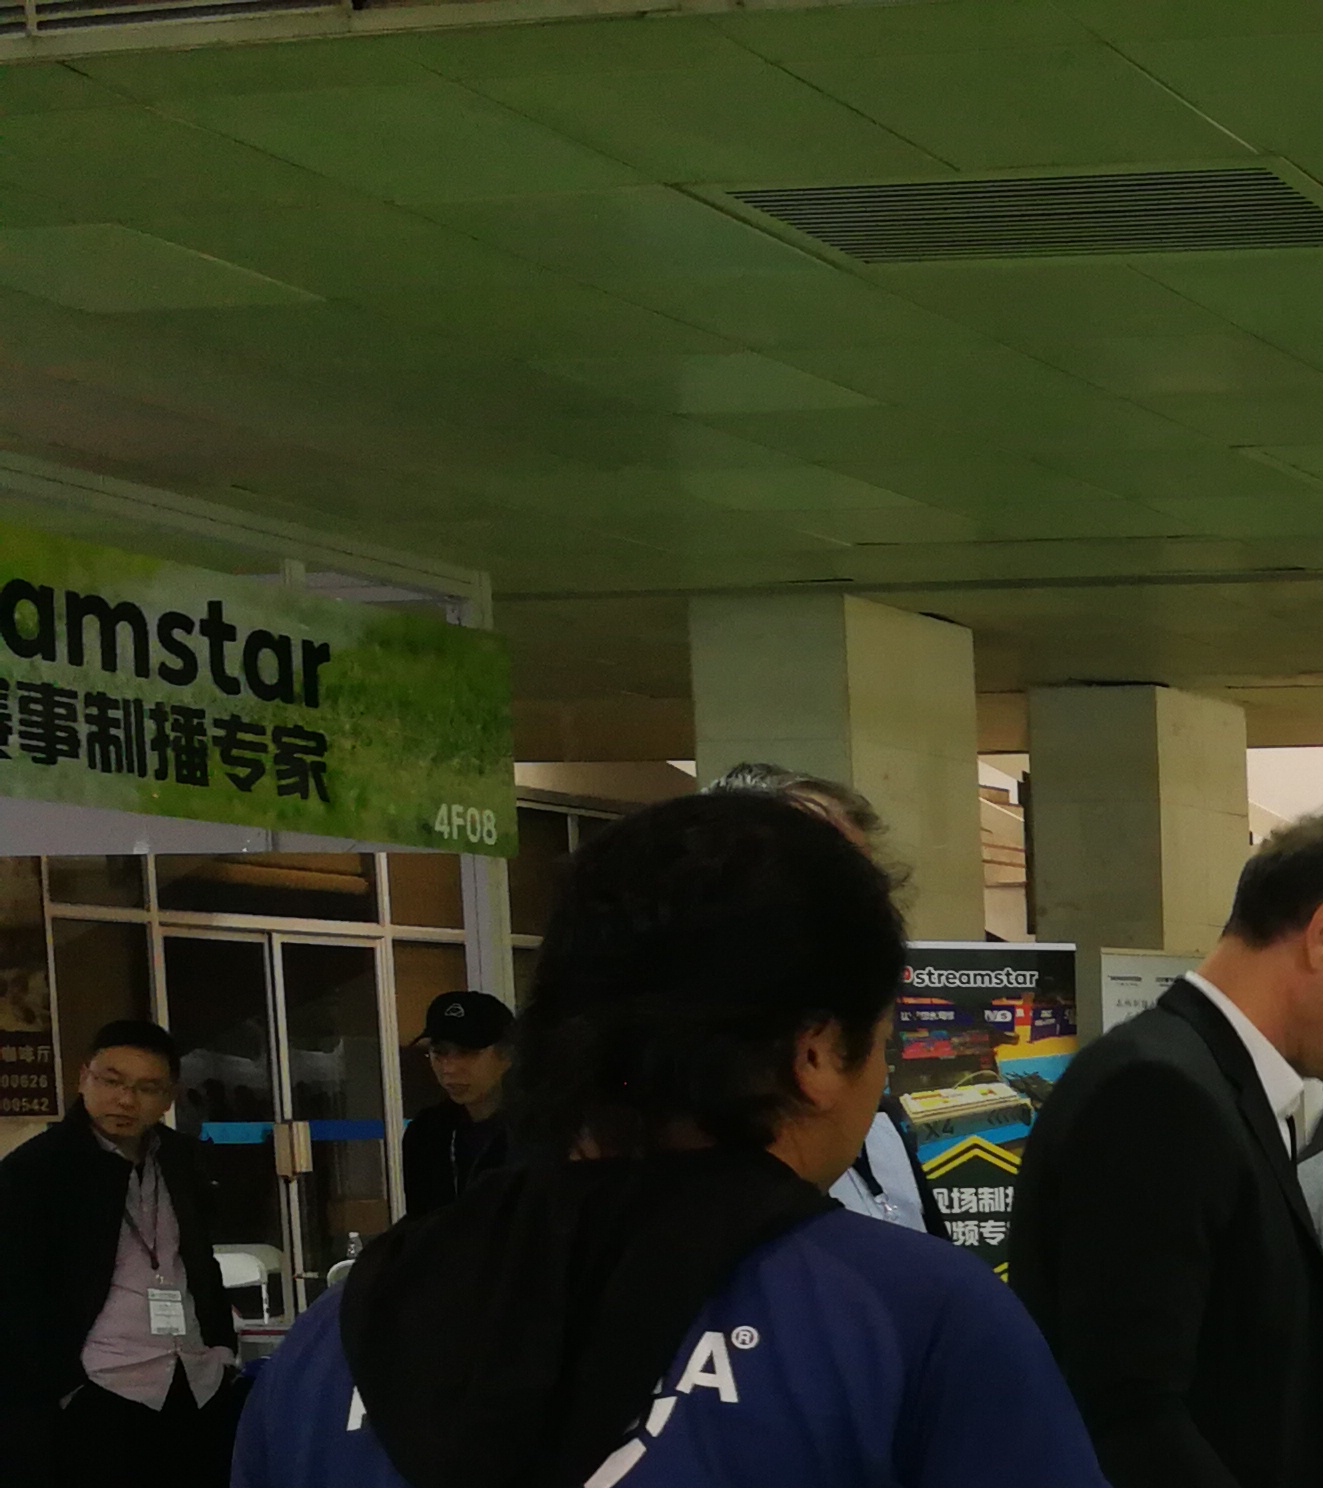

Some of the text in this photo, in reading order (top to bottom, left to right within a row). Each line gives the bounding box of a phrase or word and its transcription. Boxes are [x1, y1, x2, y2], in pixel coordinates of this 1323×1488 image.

[0, 678, 331, 803] 事制播专家
[433, 801, 498, 846] 4F08
[913, 965, 1039, 988] streamstar
